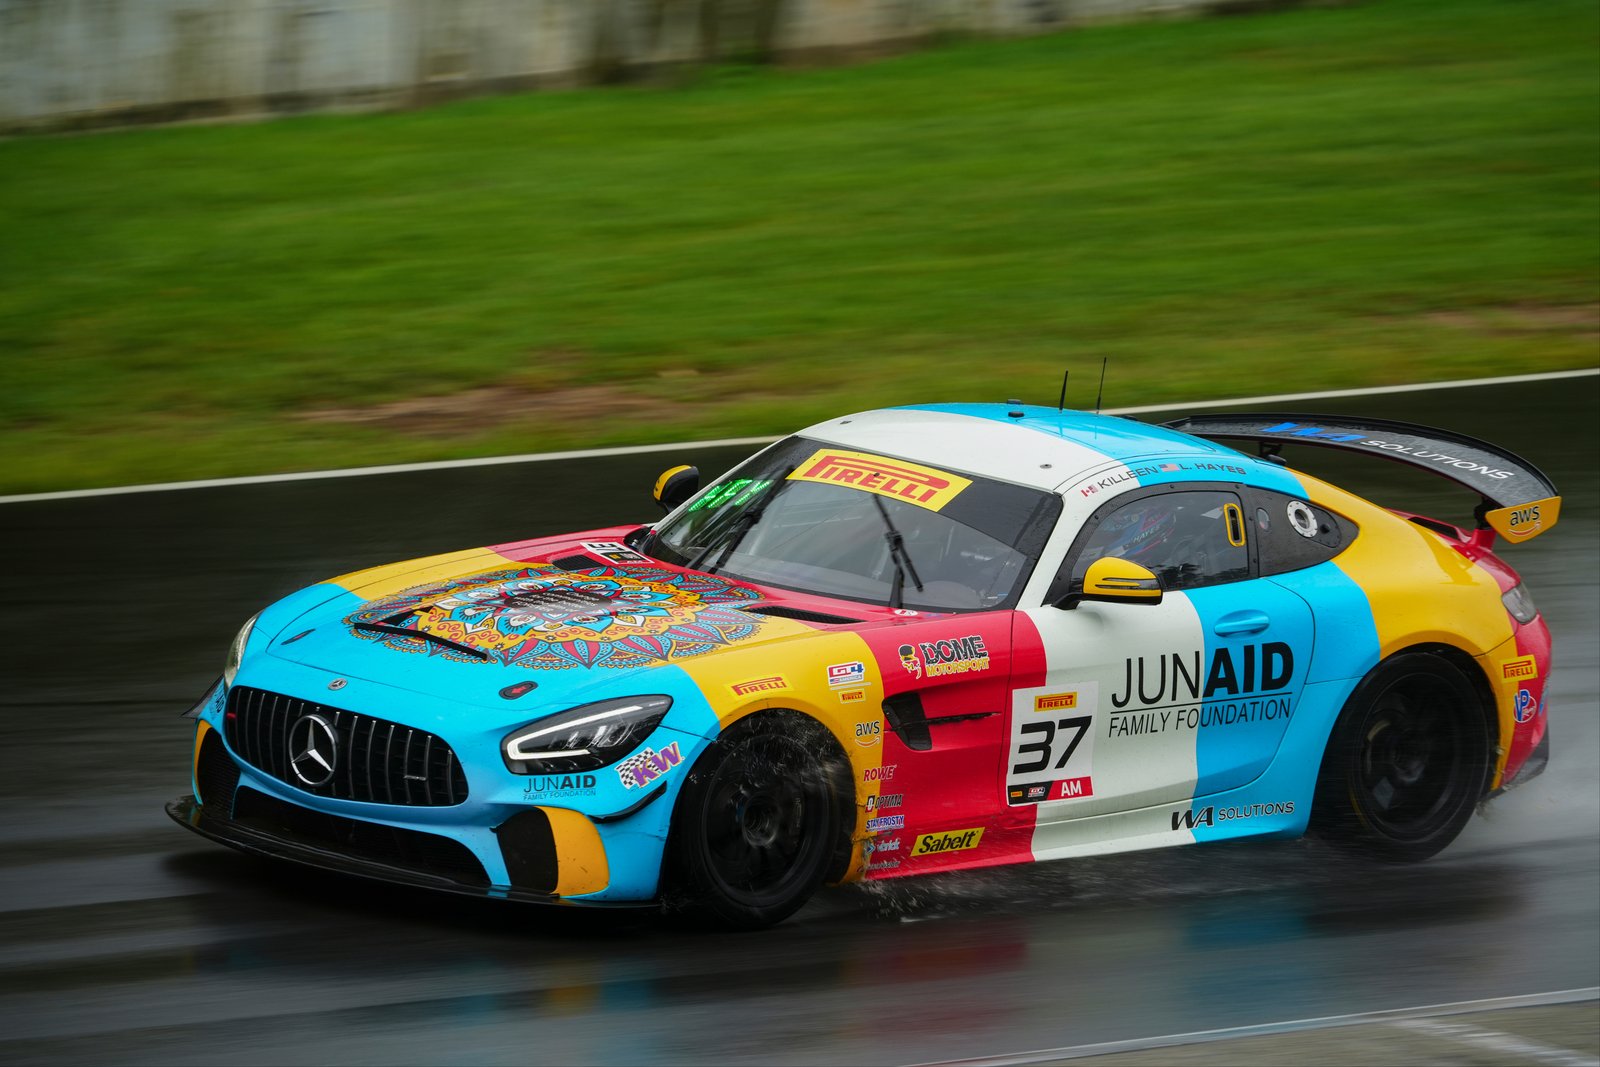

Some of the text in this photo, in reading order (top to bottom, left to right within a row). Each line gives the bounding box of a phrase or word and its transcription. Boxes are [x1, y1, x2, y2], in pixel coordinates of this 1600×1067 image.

[1360, 439, 1514, 479] SOLUTIONS
[803, 455, 950, 502] PIRELLI
[1097, 466, 1160, 489] KILLEEN
[1195, 463, 1247, 475] HAYES
[1510, 505, 1540, 526] aws
[919, 635, 988, 665] DOME
[926, 658, 990, 677] MOTORSPORT
[1111, 641, 1294, 708] JUNAID
[1503, 660, 1533, 679] PIRELLI
[731, 676, 787, 696] PIRELLI
[842, 691, 863, 700] PIRELLI
[1038, 695, 1073, 709] PIRELLI
[1514, 689, 1530, 721] VP
[1109, 698, 1291, 738] FAMILY FOUNDATION
[855, 721, 880, 737] aws
[1013, 715, 1093, 775] 37
[632, 742, 682, 787] KW
[864, 764, 898, 781] ROWE
[523, 775, 596, 792] JUNAID
[1061, 780, 1082, 797] AM
[523, 789, 596, 801] FAMILY FOUNDATION
[875, 794, 903, 809] OPTIMA
[1171, 802, 1295, 831] WA SOLUTIONS
[919, 831, 976, 853] Sabelt
